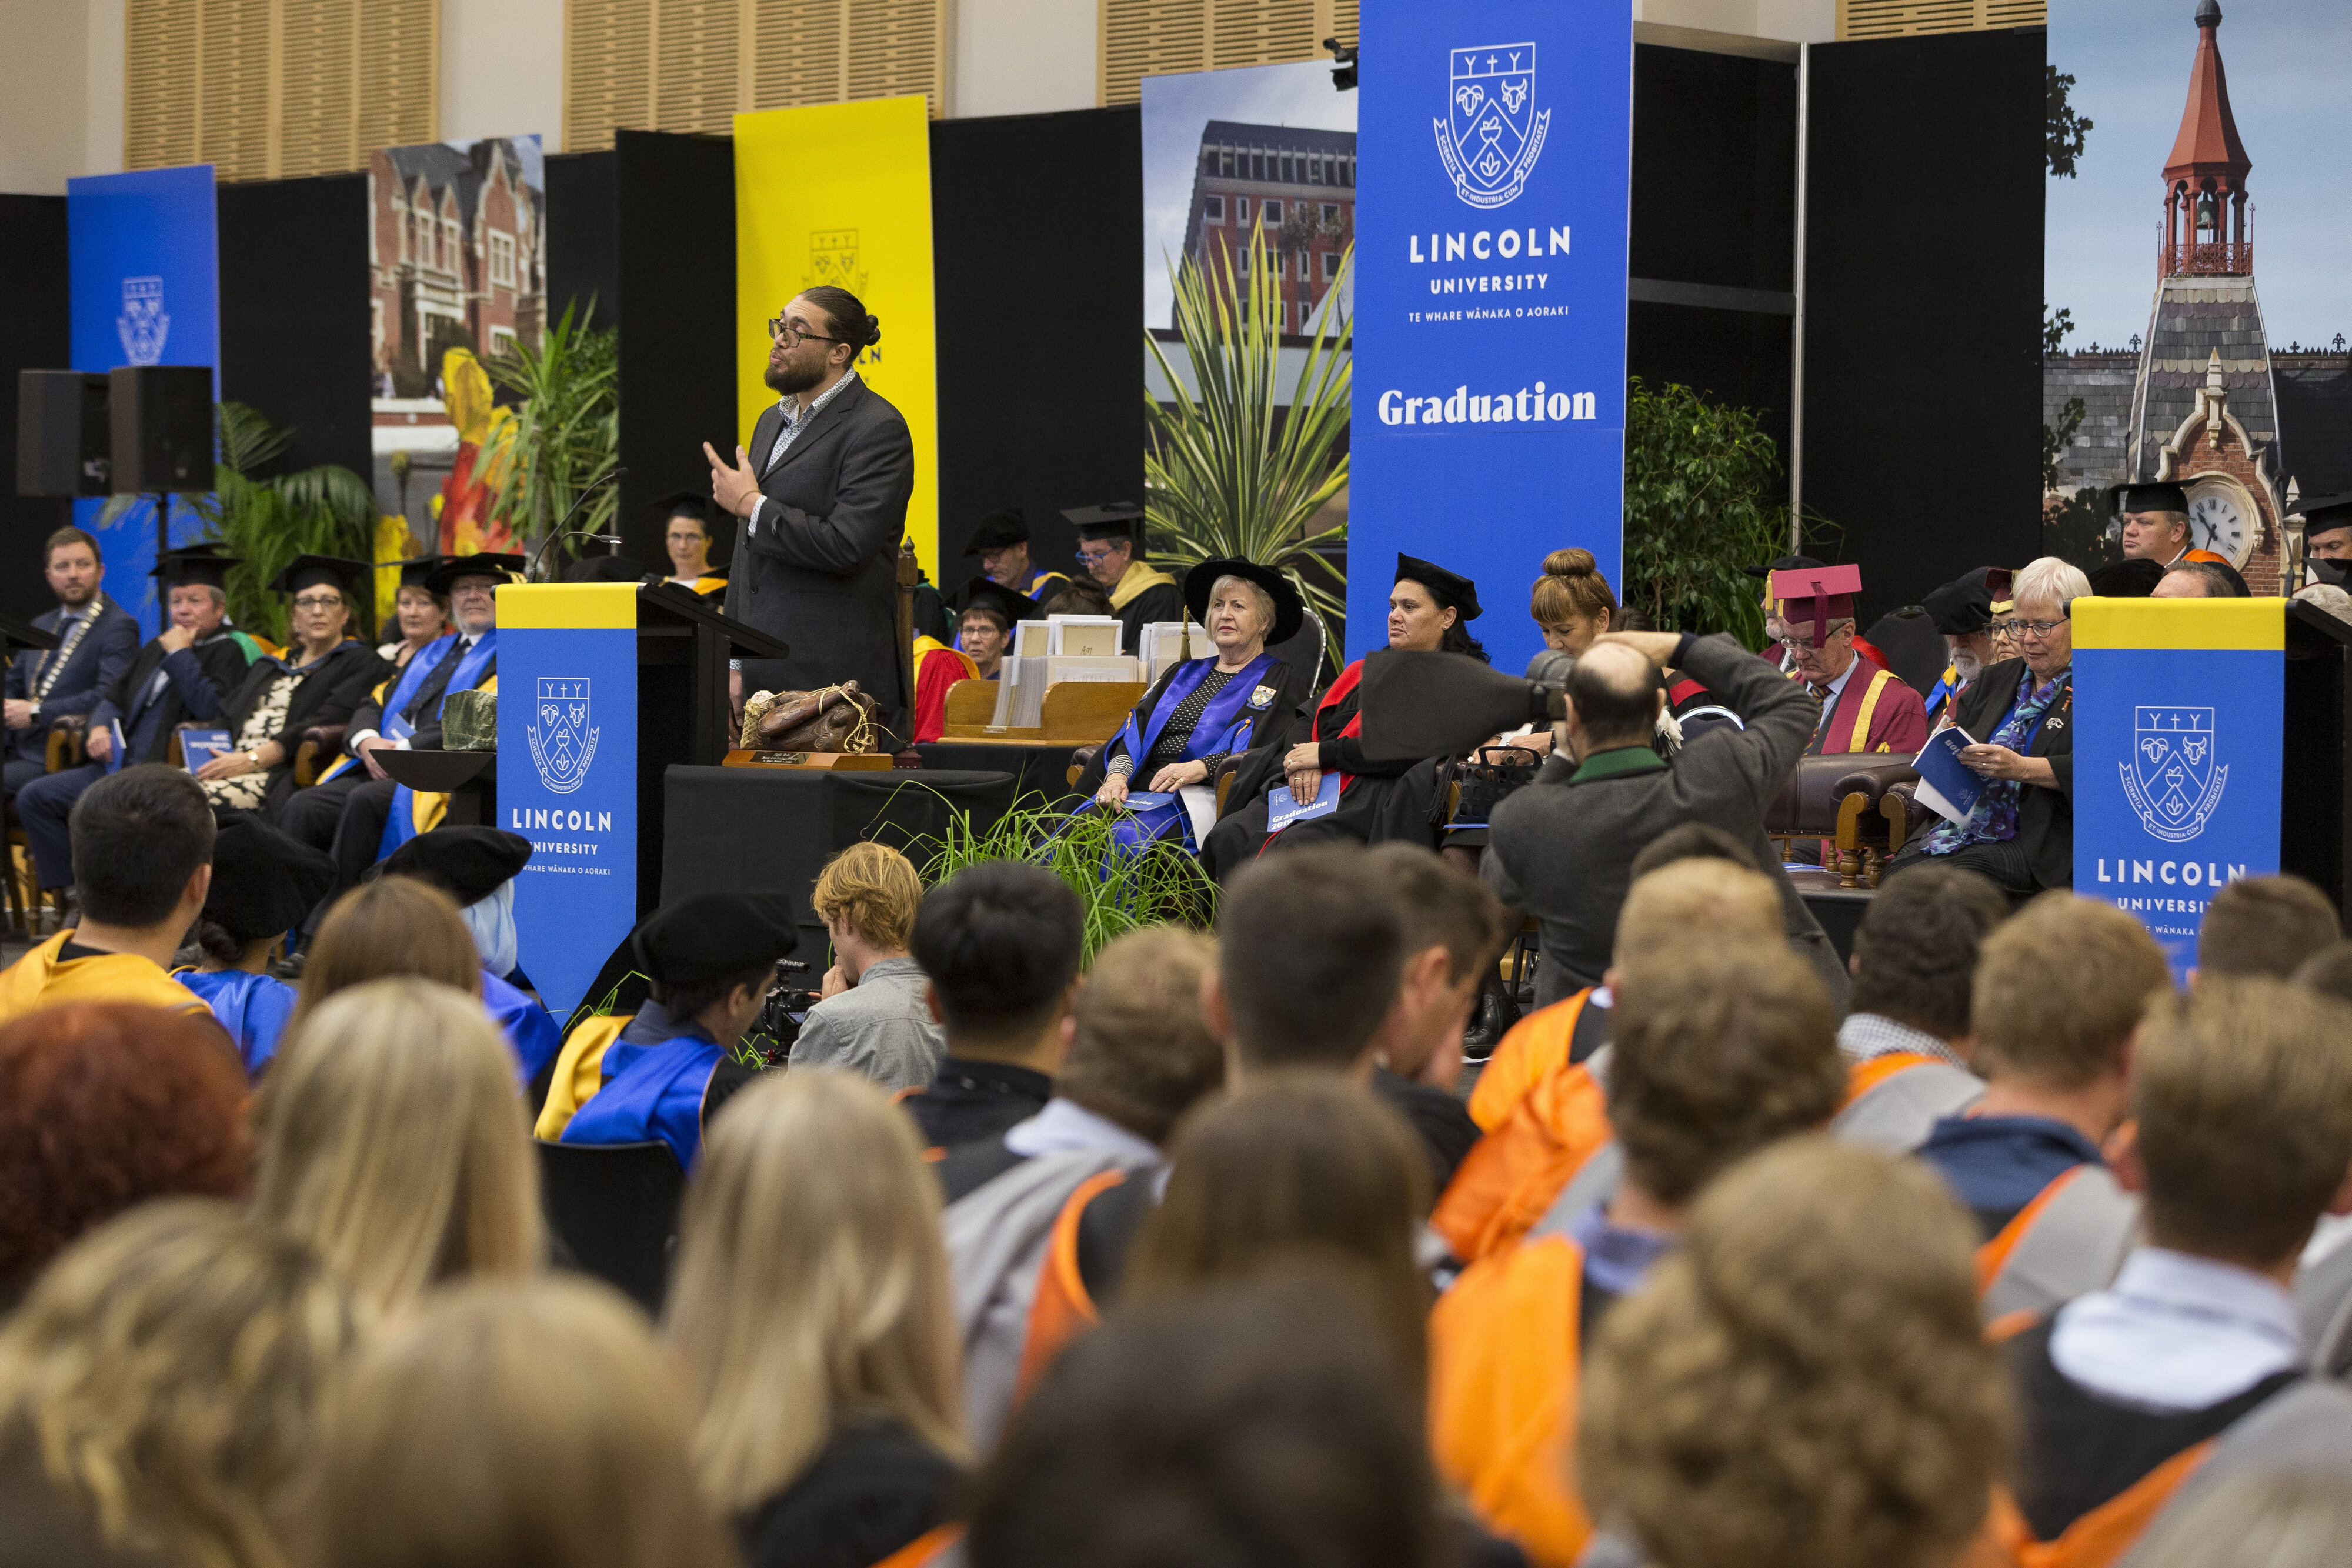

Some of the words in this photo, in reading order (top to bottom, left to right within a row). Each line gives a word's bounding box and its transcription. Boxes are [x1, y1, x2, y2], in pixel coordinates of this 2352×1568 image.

[1440, 135, 1457, 174] SCIENTIA
[1504, 185, 1519, 198] CUM
[1523, 124, 1544, 168] PROBITATE
[1410, 226, 1570, 263] LINCOLN
[1430, 273, 1548, 295] UNIVERSITY
[1409, 312, 1420, 322] TE
[1425, 310, 1462, 321] WHARE
[1466, 307, 1511, 319] WĀNAKA
[1515, 308, 1523, 318] O
[1527, 306, 1569, 317] AORAKI
[1378, 381, 1596, 426] Graduation
[1272, 801, 1328, 823] Graduation
[2125, 776, 2142, 809] SCIENTIA
[2186, 826, 2199, 836] CUM
[2203, 777, 2223, 812] PROBITATE
[513, 808, 611, 832] LINCOLN
[1271, 818, 1293, 830] 2019
[529, 842, 598, 855] NIVERSITY
[548, 864, 576, 873] WĀNAKA
[2098, 859, 2246, 886] LINCOLN
[2117, 897, 2211, 913] UNIVERSI
[2154, 925, 2194, 936] WĀNAKA
